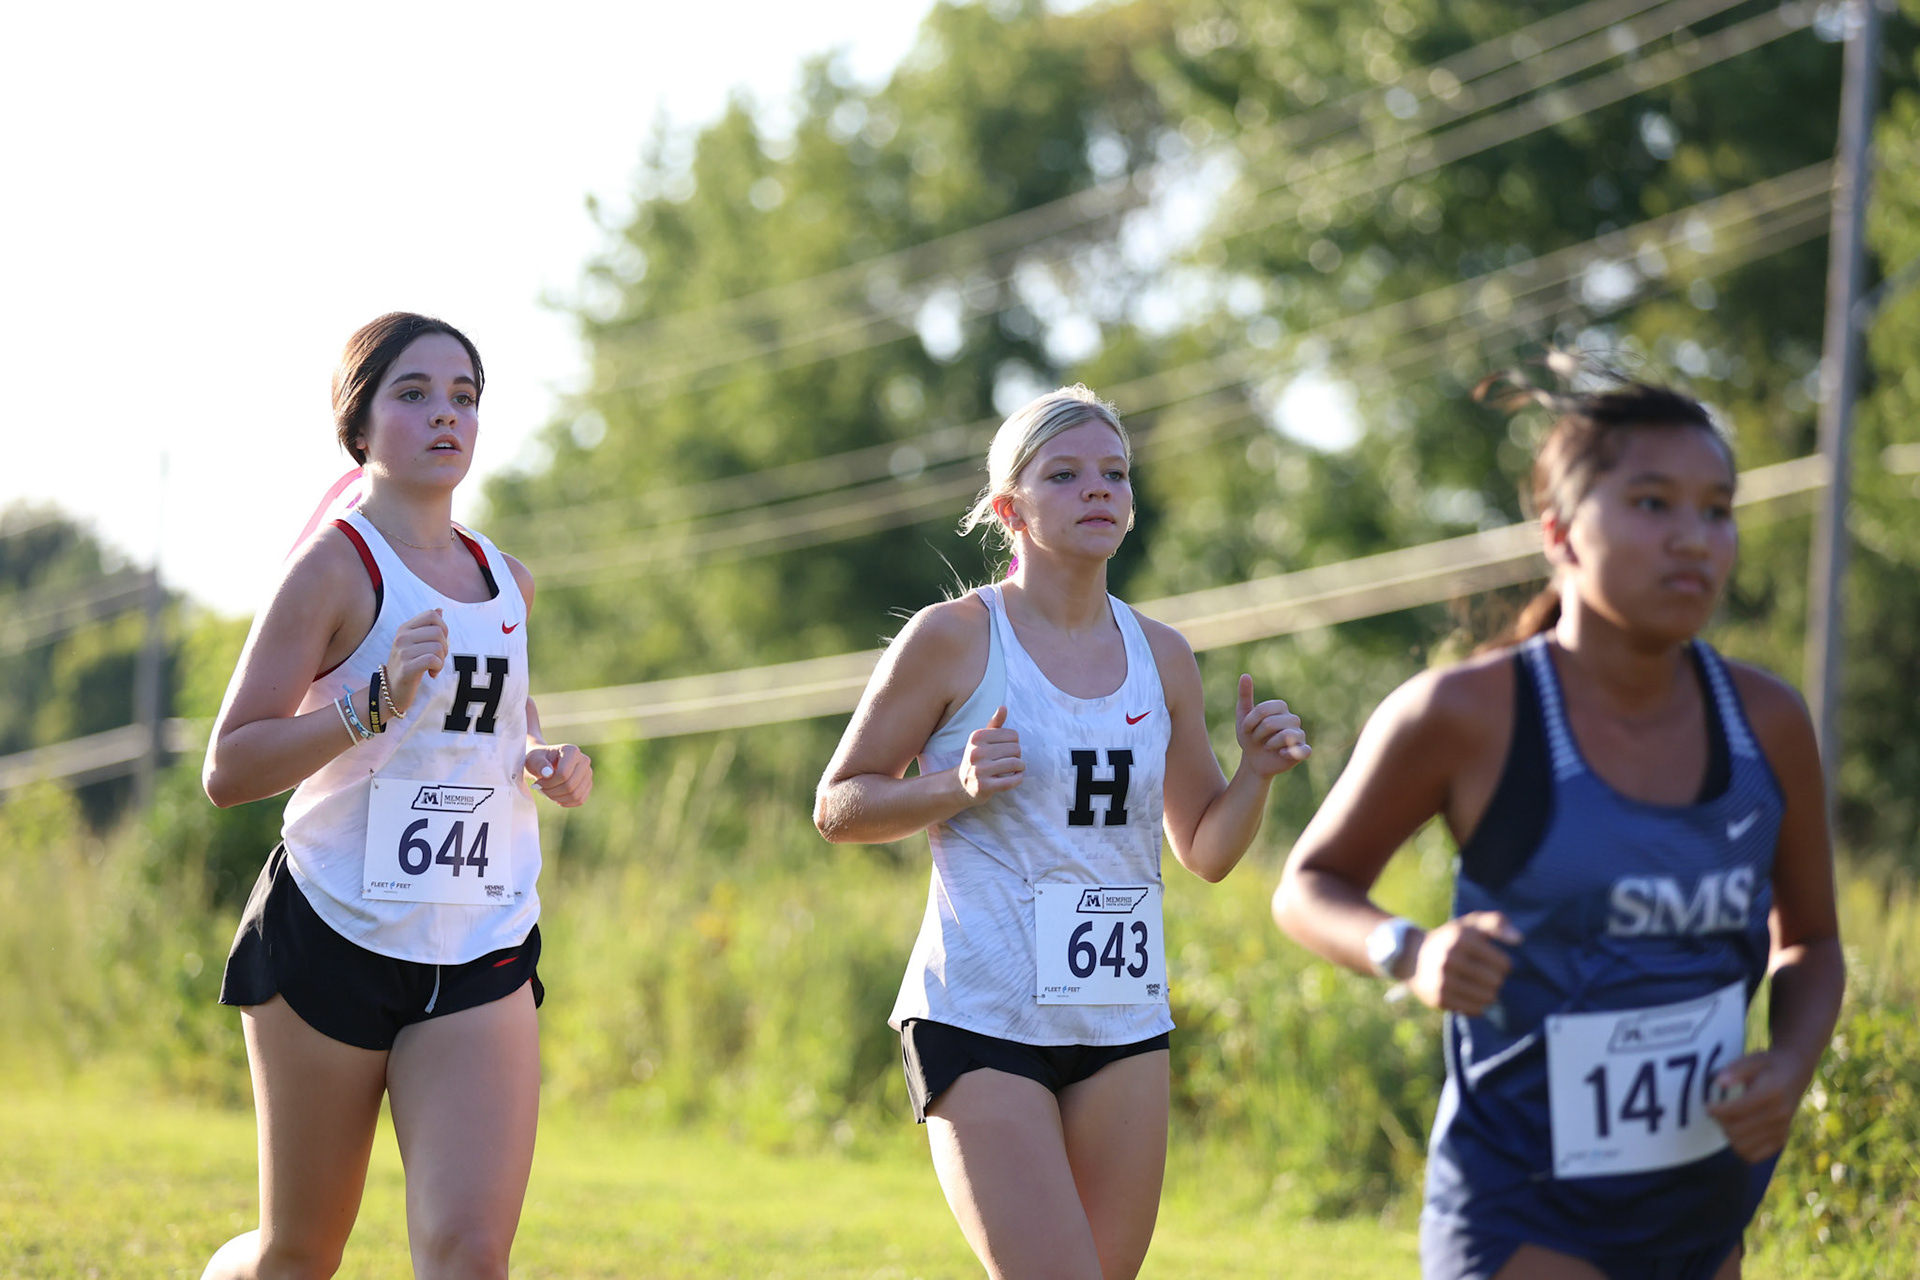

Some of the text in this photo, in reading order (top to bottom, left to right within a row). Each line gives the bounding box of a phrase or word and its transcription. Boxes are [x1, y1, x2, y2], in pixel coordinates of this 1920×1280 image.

[443, 654, 509, 735] H
[444, 795, 474, 803] MEMPHIS
[1067, 748, 1135, 828] H
[398, 818, 489, 878] 644
[1608, 867, 1754, 936] SMS
[1068, 920, 1148, 979] 643
